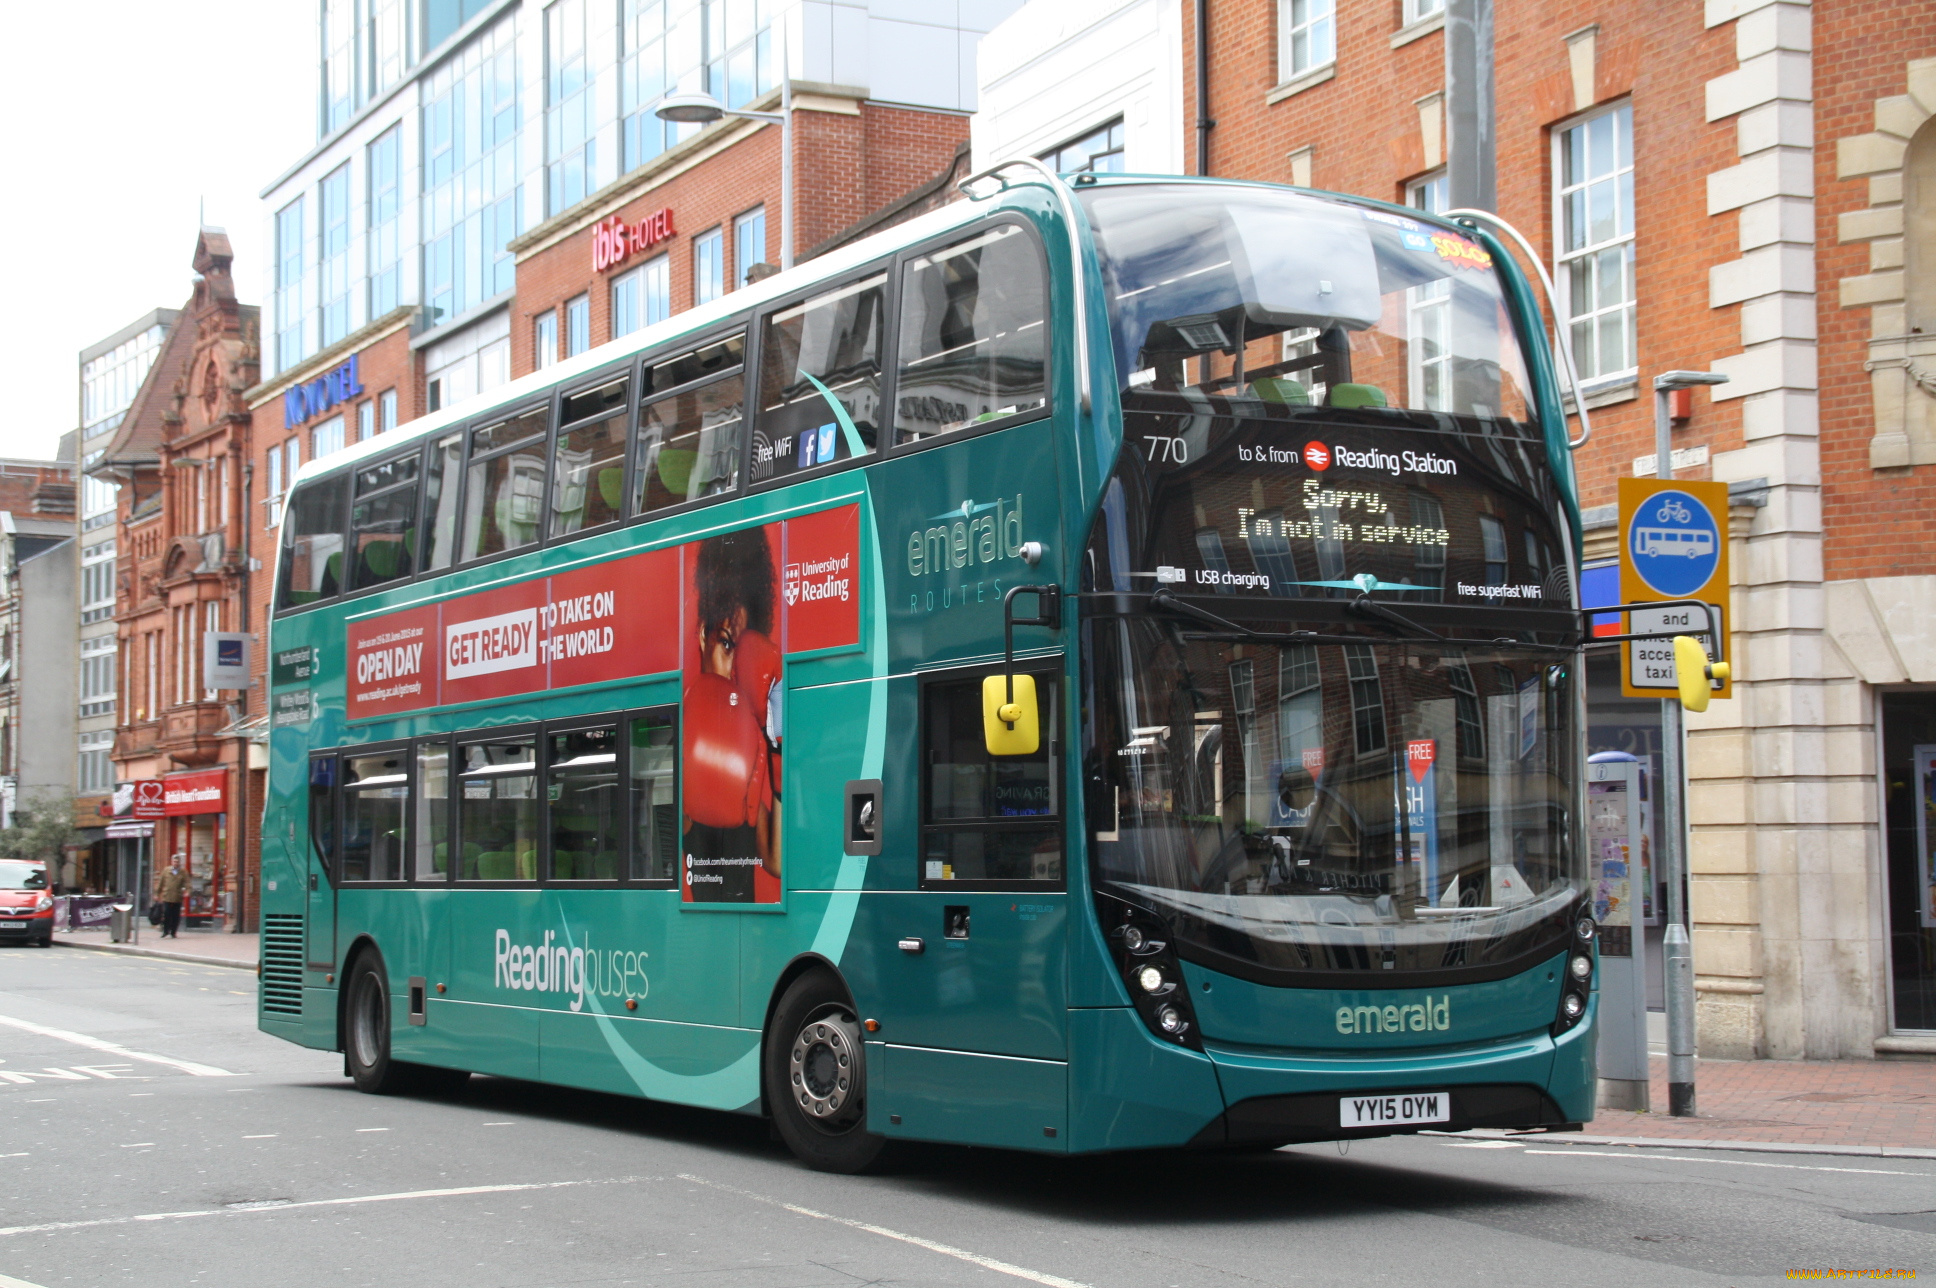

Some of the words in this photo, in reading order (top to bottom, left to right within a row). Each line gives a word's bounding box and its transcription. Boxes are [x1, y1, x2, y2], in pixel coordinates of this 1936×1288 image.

[593, 215, 628, 273] ibis
[630, 208, 676, 255] HOTEL
[285, 353, 364, 430] NOVOTEL
[757, 444, 774, 464] free
[774, 436, 792, 458] WiFi
[1143, 435, 1188, 464] 770
[1238, 444, 1253, 462] to
[1255, 445, 1267, 463] &
[1269, 446, 1299, 464] from
[1335, 446, 1401, 476] Reading
[1402, 450, 1457, 476] Station
[1303, 478, 1388, 514] Sorry,
[907, 493, 1023, 577] emerald
[1238, 507, 1272, 538] I'm
[1281, 515, 1325, 539] not
[1332, 519, 1353, 541] in
[1361, 524, 1450, 546] service
[802, 556, 840, 576] University
[840, 552, 850, 569] of
[802, 574, 850, 602] Reading
[1195, 569, 1220, 584] USB
[1222, 571, 1270, 590] charging
[1457, 581, 1477, 596] free
[1478, 583, 1521, 600] superfast
[1521, 584, 1542, 599] WiFi
[539, 602, 557, 631] TO
[558, 595, 592, 625] TAKE
[593, 590, 614, 619] ON
[910, 578, 1001, 614] ROUTES
[1662, 612, 1689, 625] and
[450, 631, 479, 667] GET
[481, 620, 533, 661] READY
[539, 634, 565, 664] THE
[565, 626, 614, 658] WORLD
[313, 647, 320, 675] 5
[357, 648, 393, 684] OPEN
[395, 641, 424, 677] DAY
[1645, 665, 1673, 679] taxi
[1302, 750, 1323, 767] FREE
[1408, 743, 1433, 760] FREE
[1335, 995, 1450, 1035] emerald
[1353, 1098, 1396, 1122] YY15
[1402, 1096, 1438, 1119] OYM
